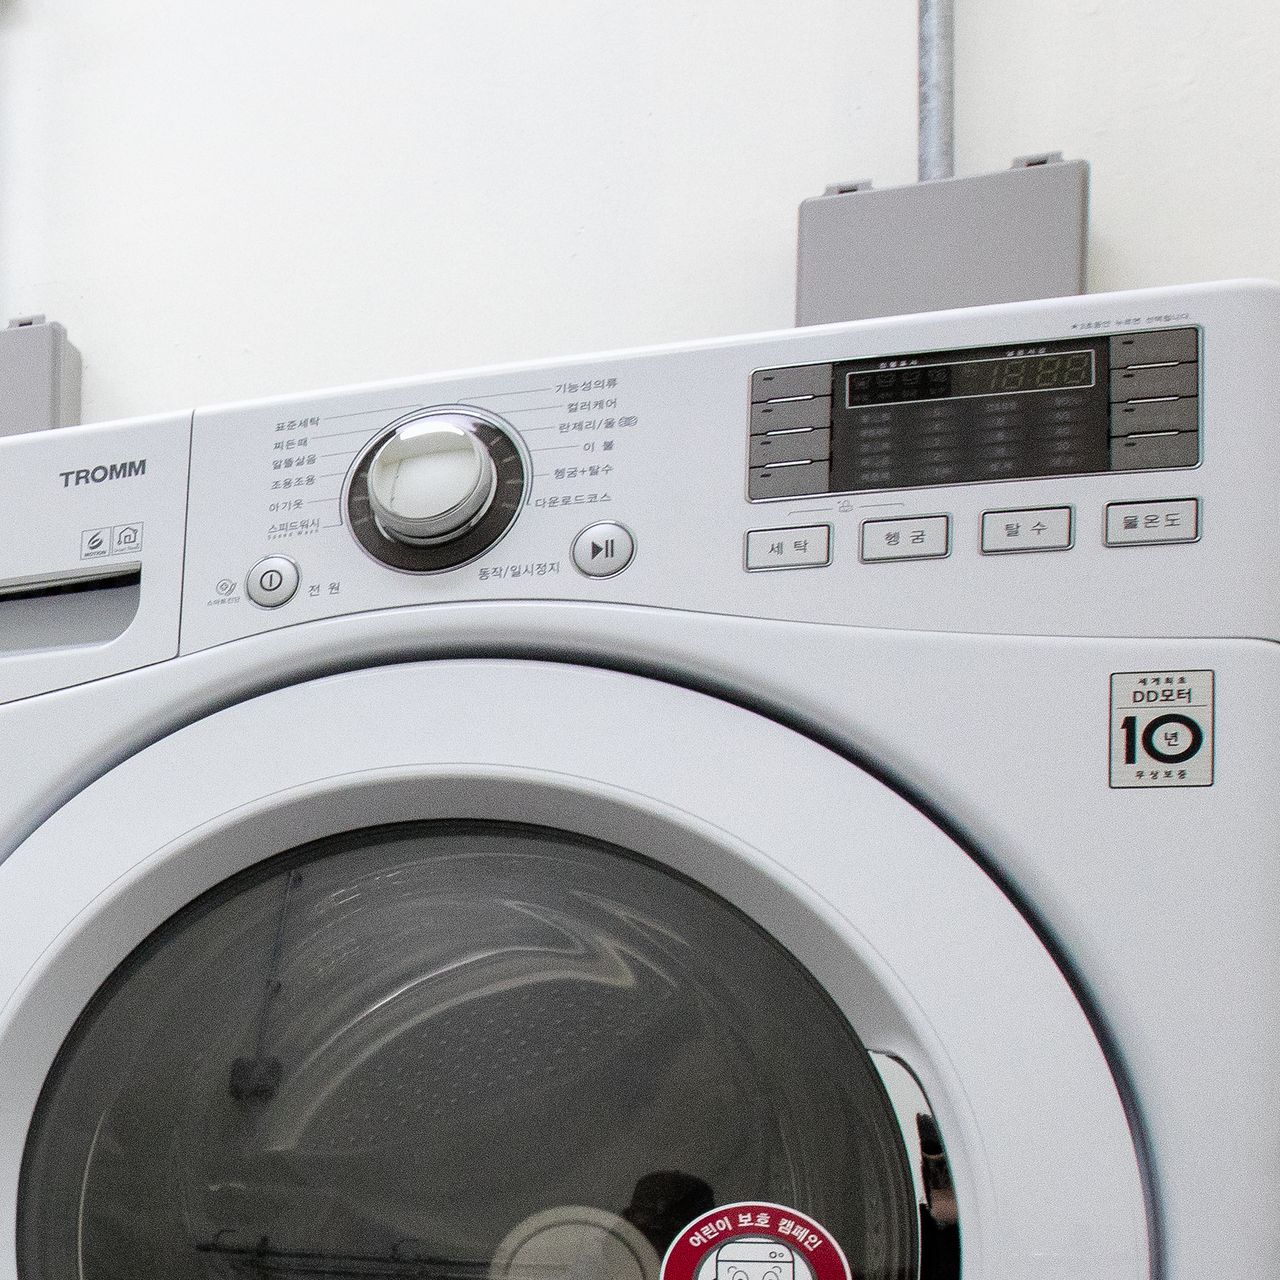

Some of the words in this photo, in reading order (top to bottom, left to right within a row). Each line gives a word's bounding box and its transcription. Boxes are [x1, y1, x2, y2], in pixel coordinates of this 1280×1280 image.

[554, 377, 618, 394] 기능성의류
[567, 398, 618, 414] 컬러케어
[275, 416, 320, 432] 표준세탁
[273, 437, 308, 451] 찌든때
[59, 459, 146, 488] TROMM
[271, 475, 316, 490] 조용조용
[268, 499, 304, 513] 아기옷
[534, 492, 612, 509] 다운로드코스
[267, 518, 320, 534] 스피드워시
[478, 561, 560, 581] 동작/일시정지
[1132, 688, 1192, 704] DD모터
[688, 1216, 733, 1248] 어린이
[737, 1212, 771, 1228] 보호
[777, 1217, 823, 1252] 캠페인
